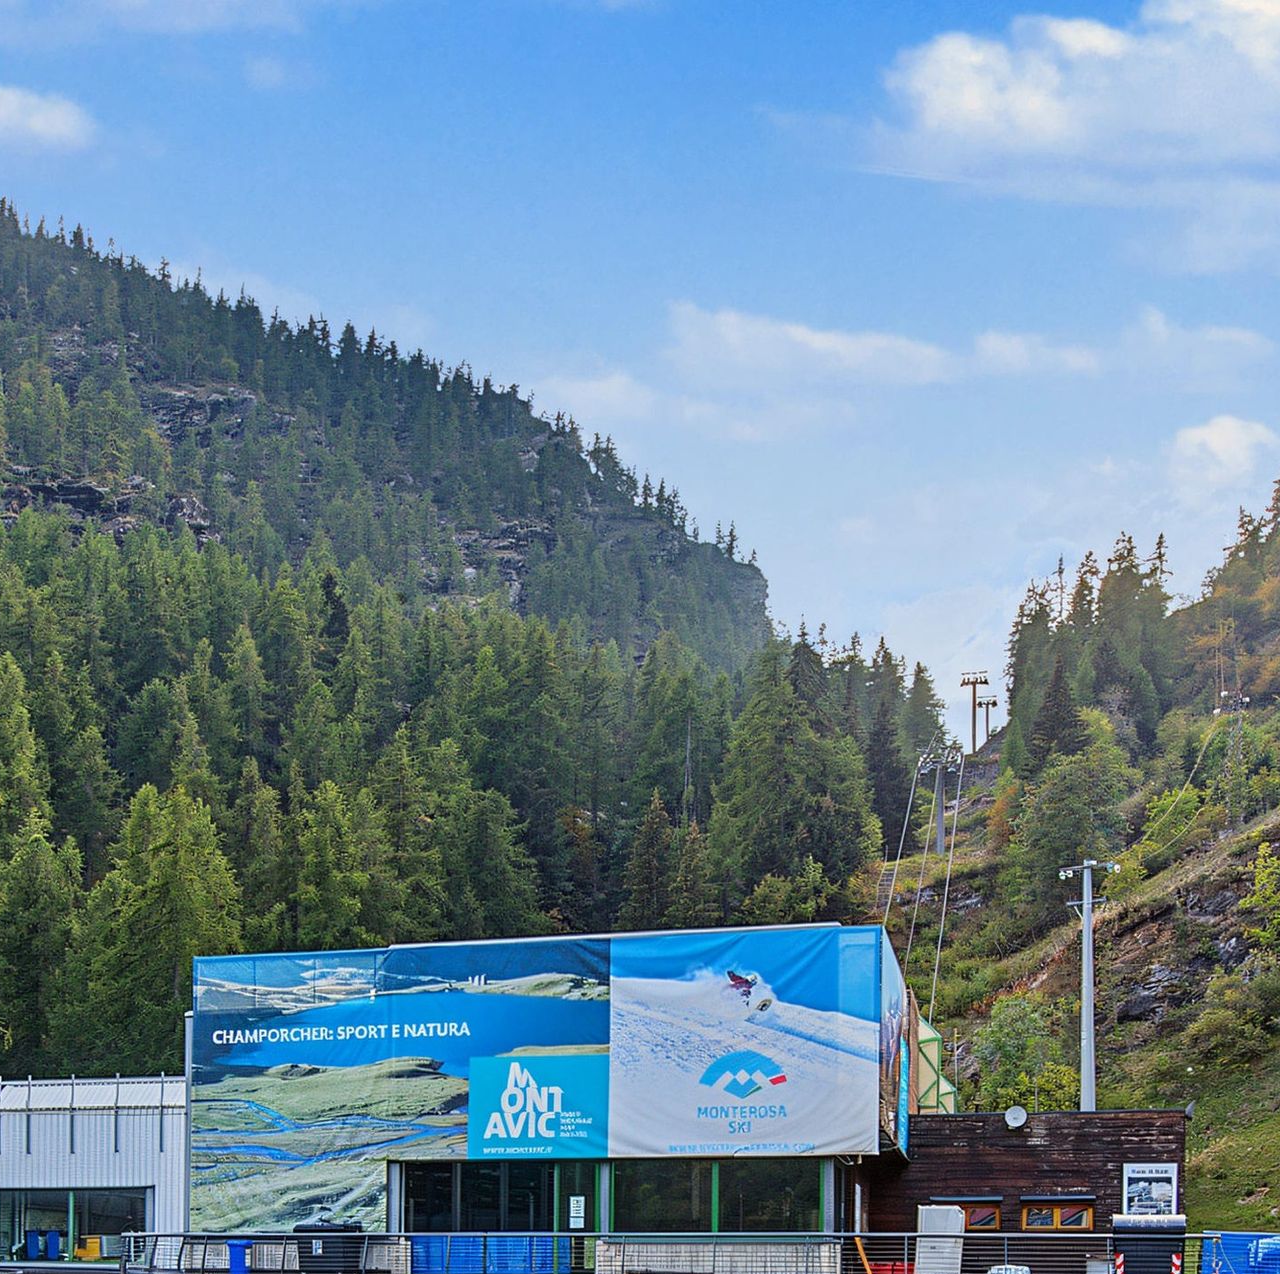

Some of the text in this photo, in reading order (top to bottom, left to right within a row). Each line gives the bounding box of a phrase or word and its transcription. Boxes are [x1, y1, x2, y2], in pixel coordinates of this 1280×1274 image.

[212, 1021, 471, 1045] CHAMPORCHER: SPORT E NATURA
[697, 1104, 788, 1120] MONTEROSA
[483, 1112, 556, 1139] AVIC
[728, 1120, 752, 1134] SKI
